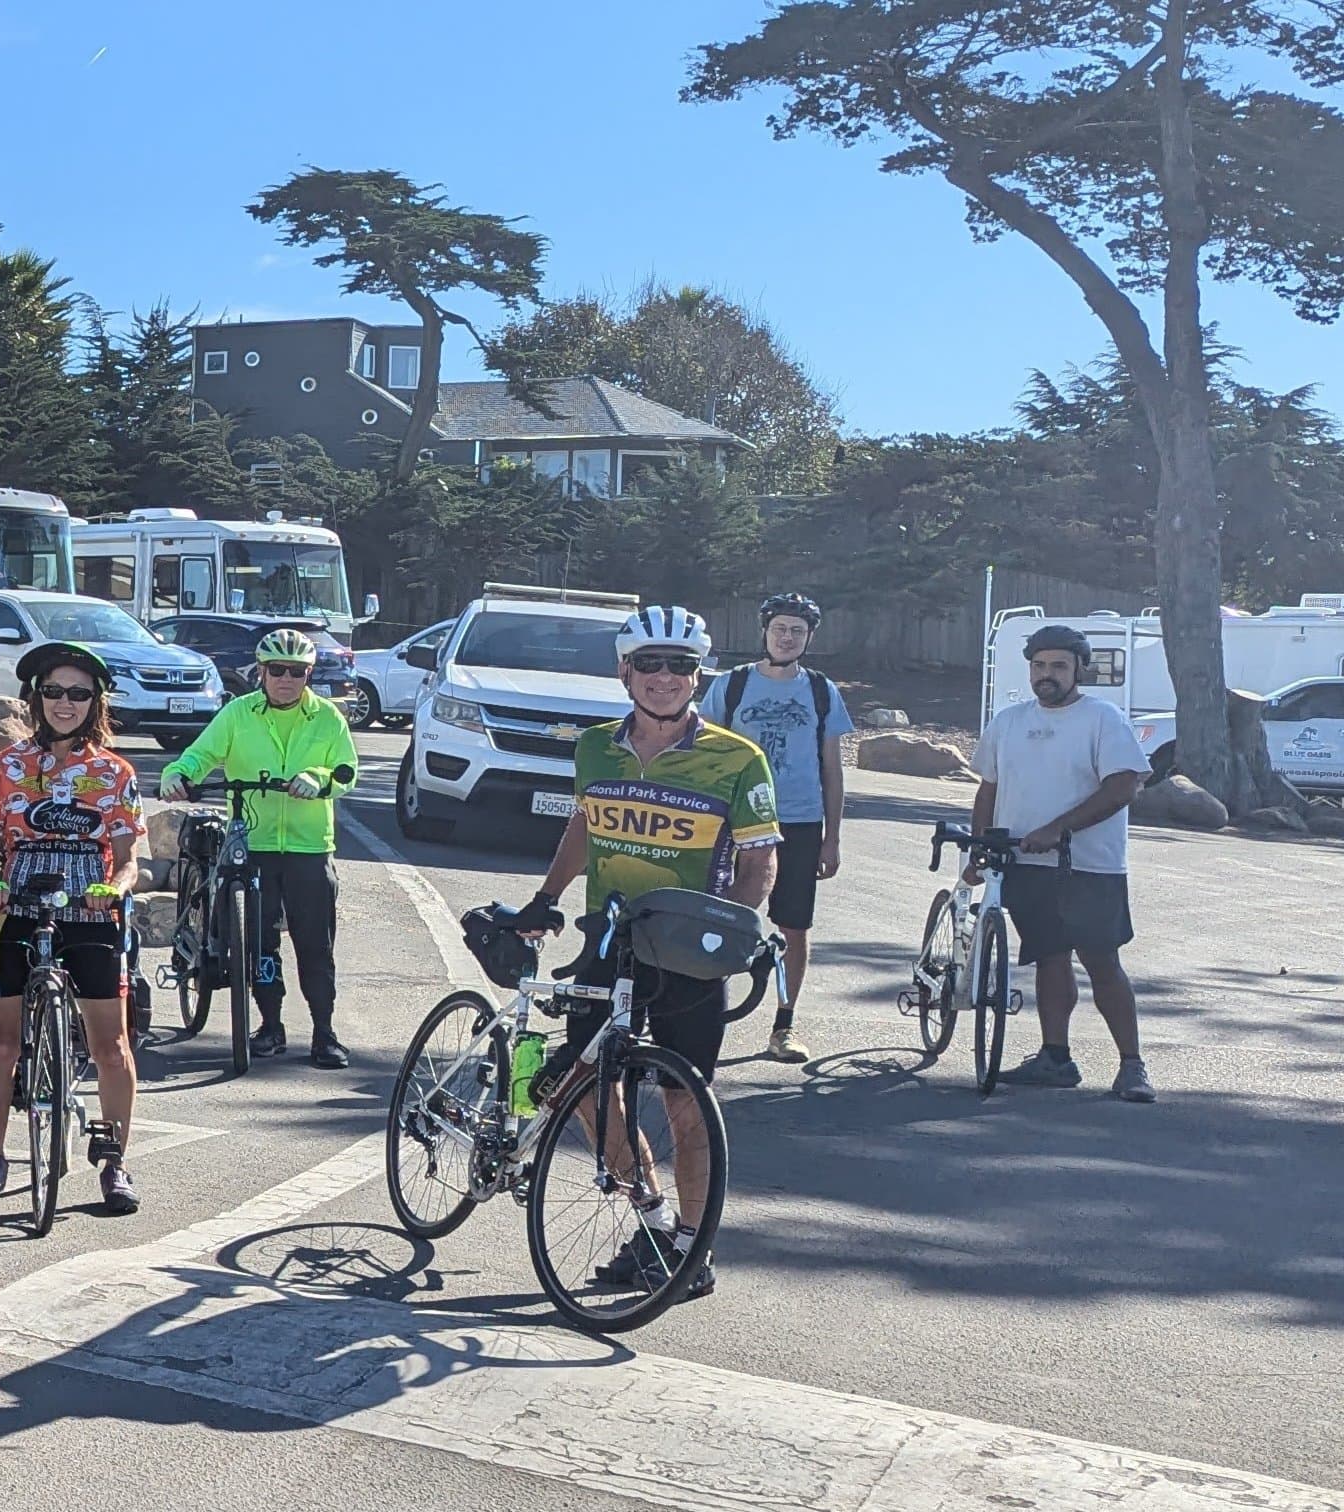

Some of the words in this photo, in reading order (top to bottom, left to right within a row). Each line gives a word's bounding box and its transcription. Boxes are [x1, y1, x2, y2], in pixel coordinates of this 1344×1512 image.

[628, 789, 657, 801] Park
[660, 791, 711, 811] Service
[585, 802, 696, 842] USNPS
[591, 836, 681, 860] www.nps.gov
